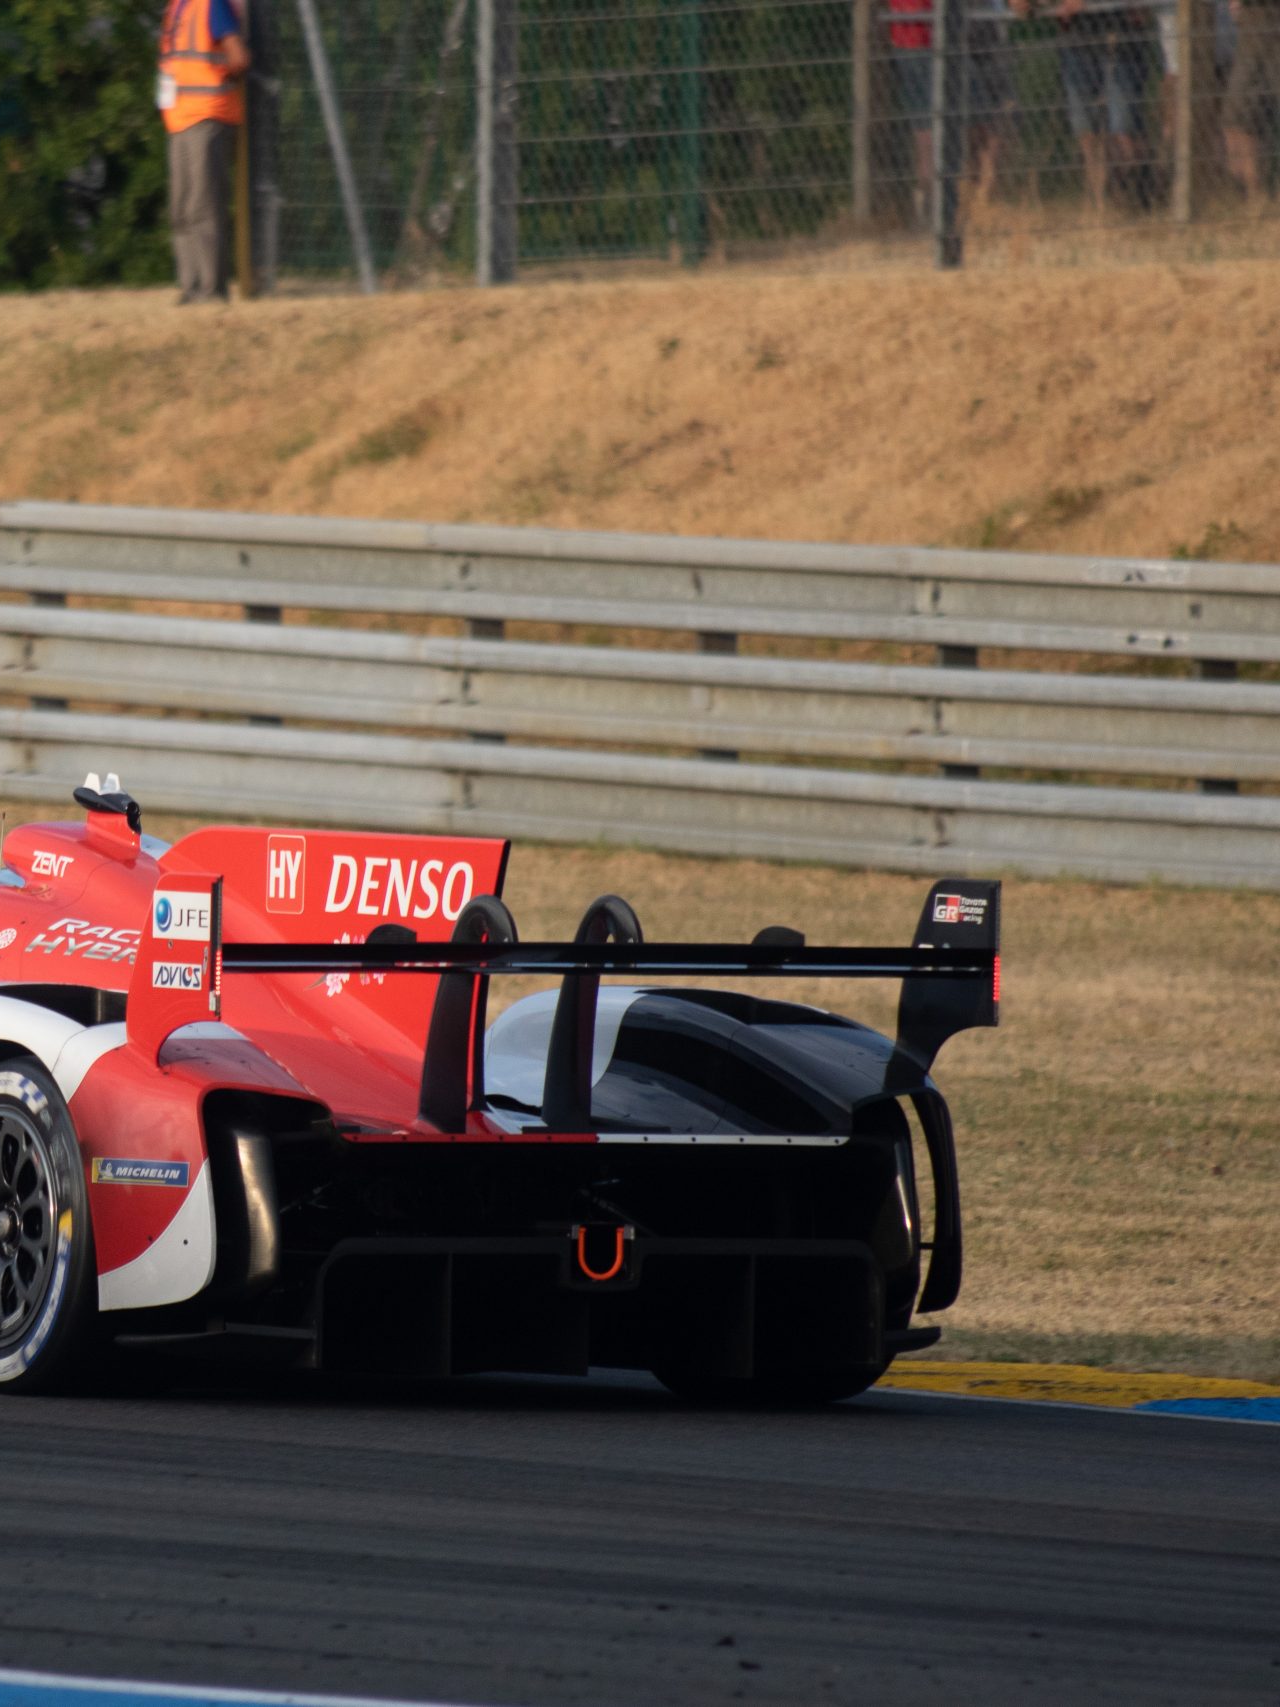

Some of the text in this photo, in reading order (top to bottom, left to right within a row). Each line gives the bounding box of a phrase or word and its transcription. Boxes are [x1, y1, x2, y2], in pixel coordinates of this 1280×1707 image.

[31, 850, 74, 878] ZENT
[269, 849, 302, 899] HY
[324, 854, 474, 921] DENSO
[174, 908, 209, 928] JFE
[934, 905, 958, 920] GR
[154, 965, 201, 988] ADVICS
[115, 1166, 181, 1180] MICHELIN
